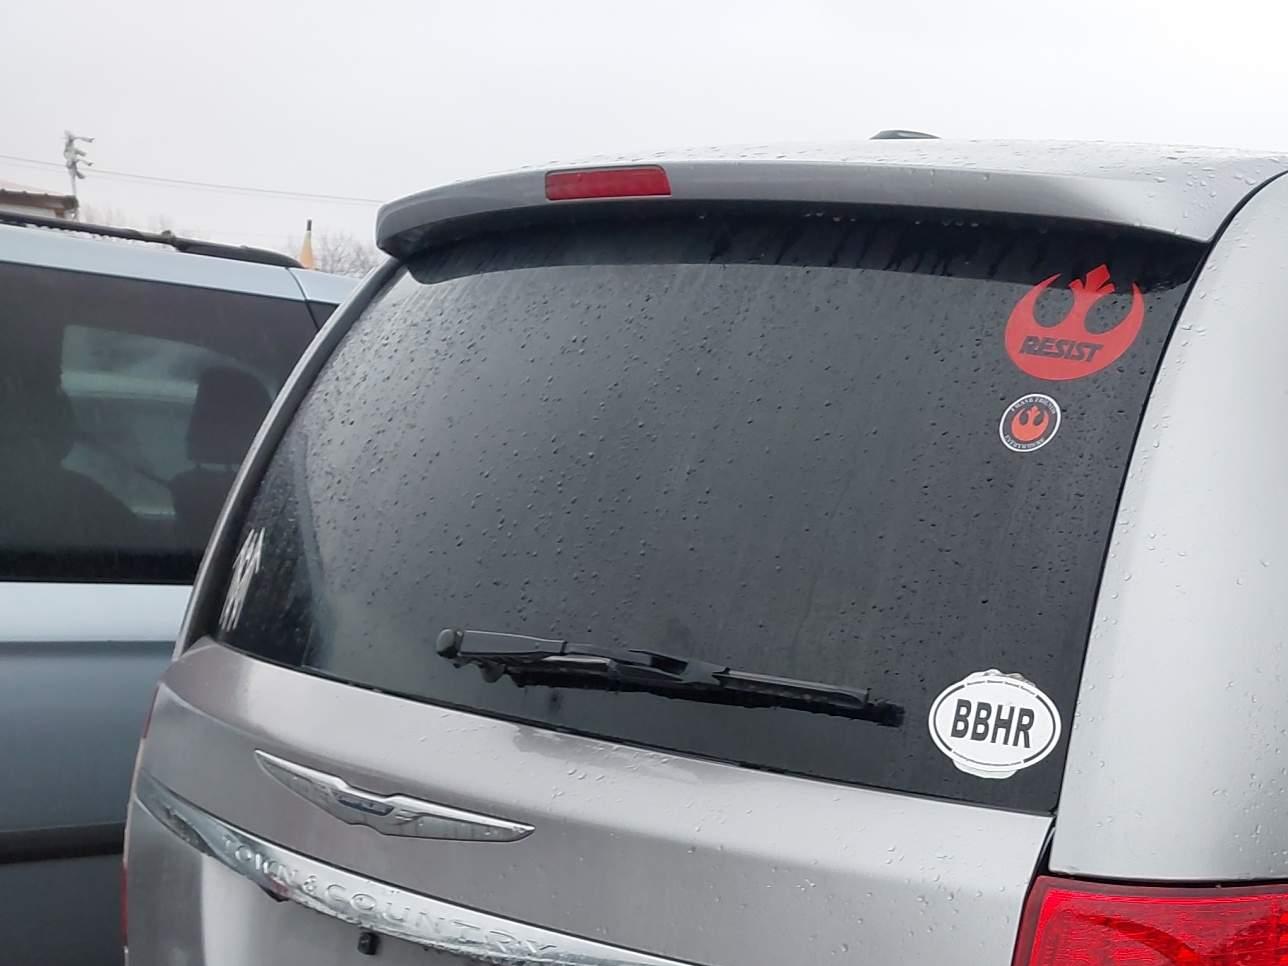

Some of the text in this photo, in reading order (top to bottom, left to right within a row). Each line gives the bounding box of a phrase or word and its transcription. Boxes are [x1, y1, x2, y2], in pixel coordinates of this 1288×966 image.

[1019, 335, 1104, 362] RESIST
[950, 698, 1035, 749] BBHR
[302, 874, 319, 894] &
[325, 883, 558, 955] COUNTRY
